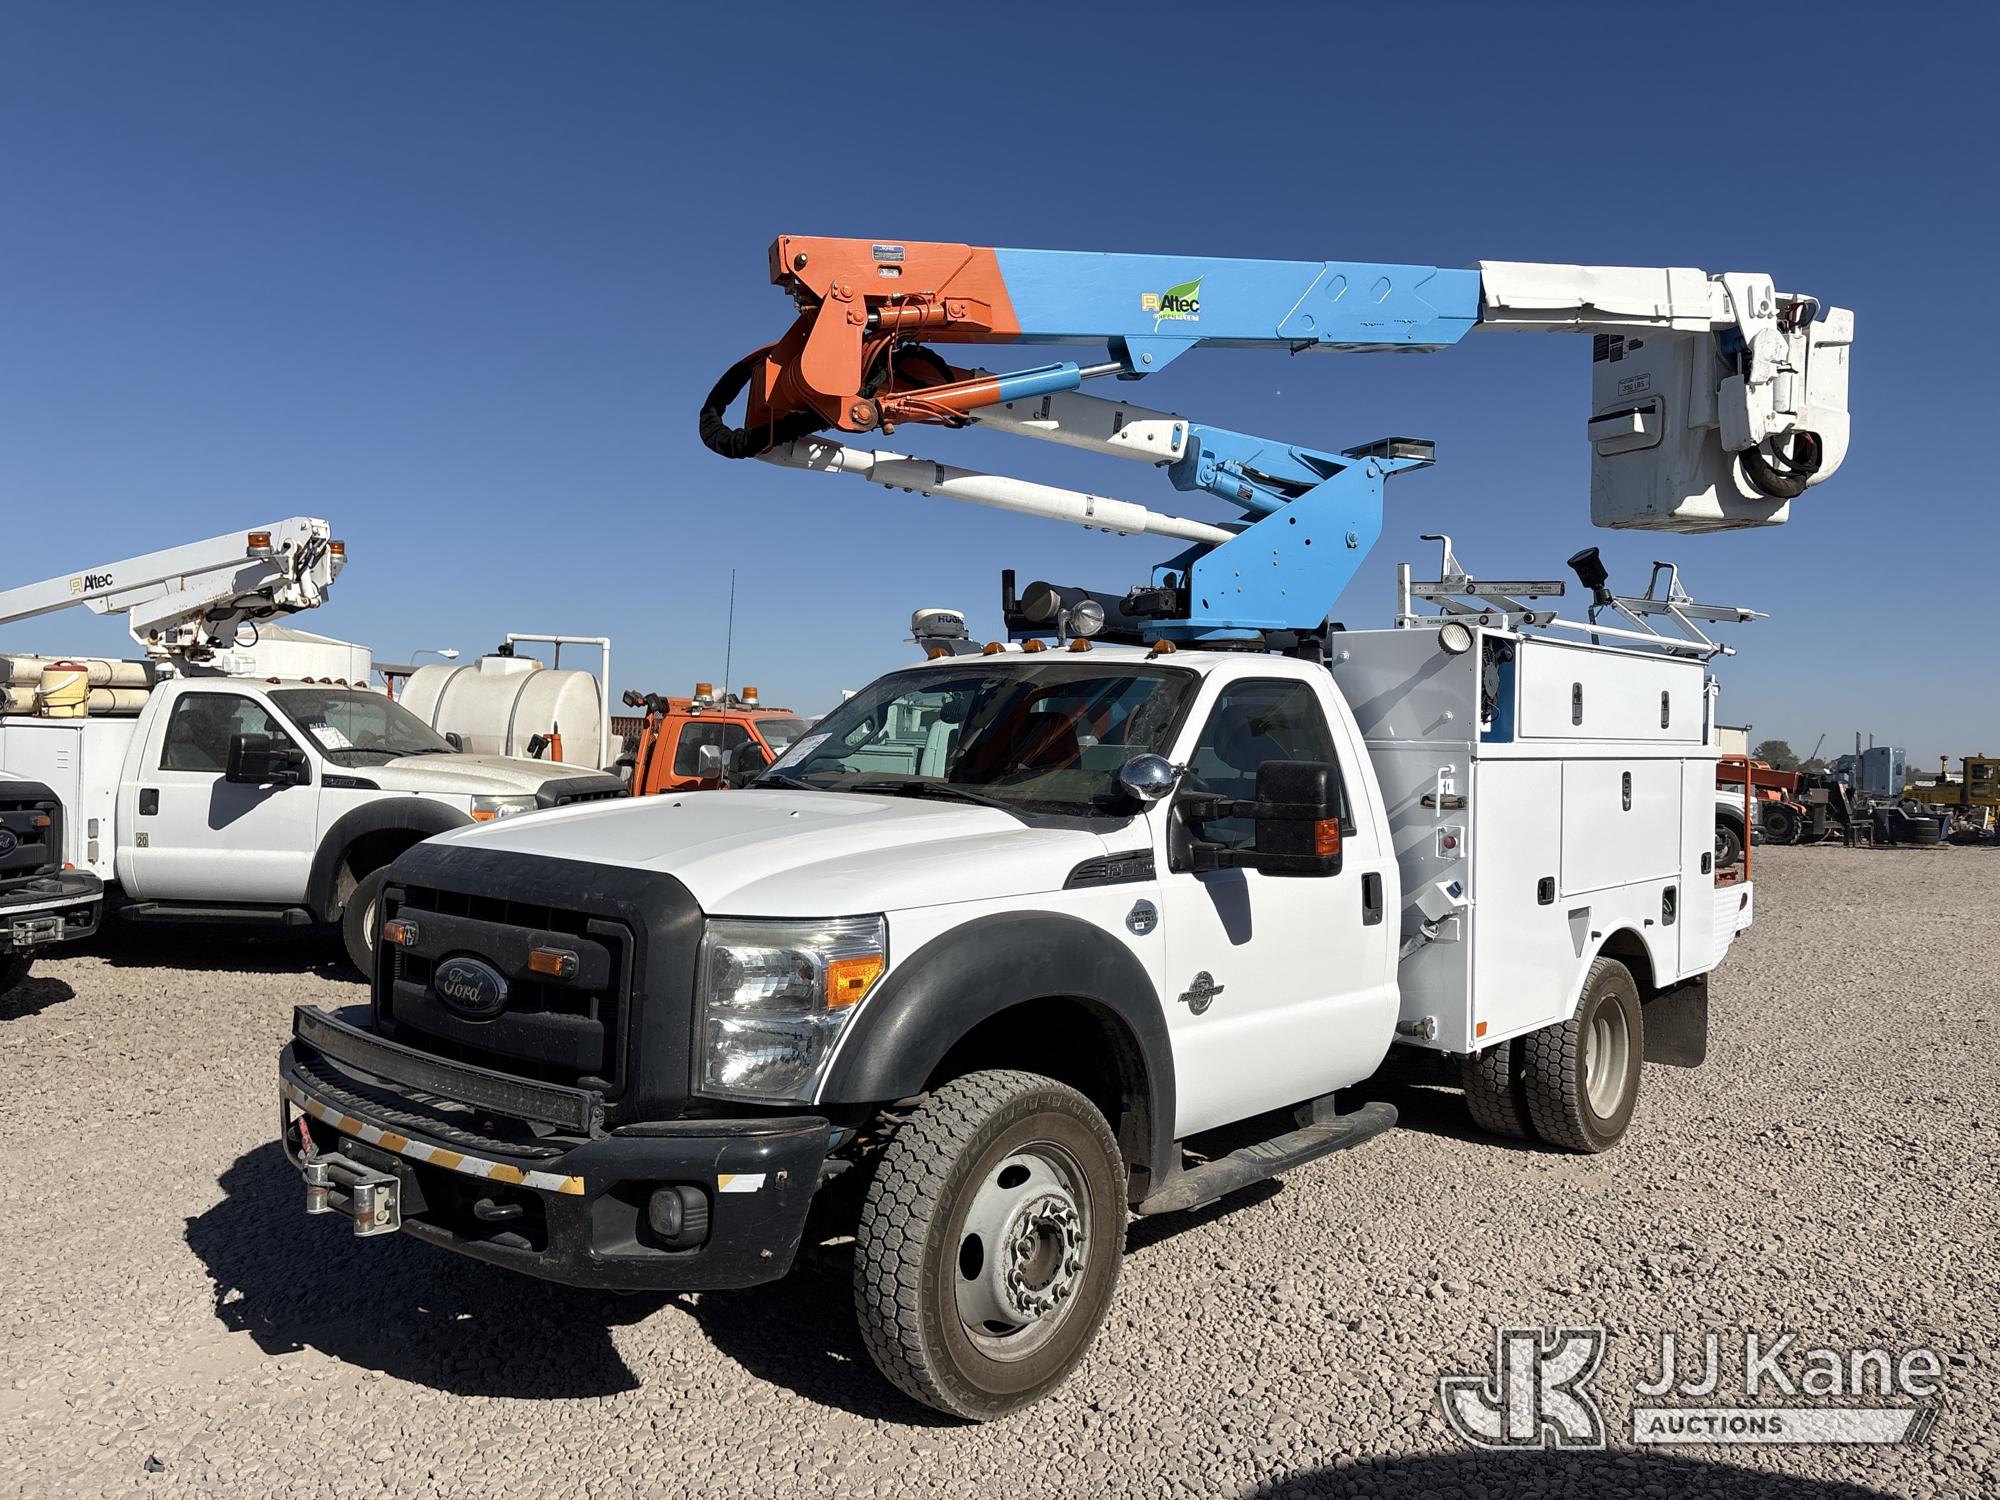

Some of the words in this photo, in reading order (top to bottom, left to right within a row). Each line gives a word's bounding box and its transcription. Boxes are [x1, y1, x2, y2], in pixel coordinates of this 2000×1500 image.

[1160, 294, 1199, 312] Altec
[84, 573, 113, 592] Altec
[444, 967, 483, 1002] Ford
